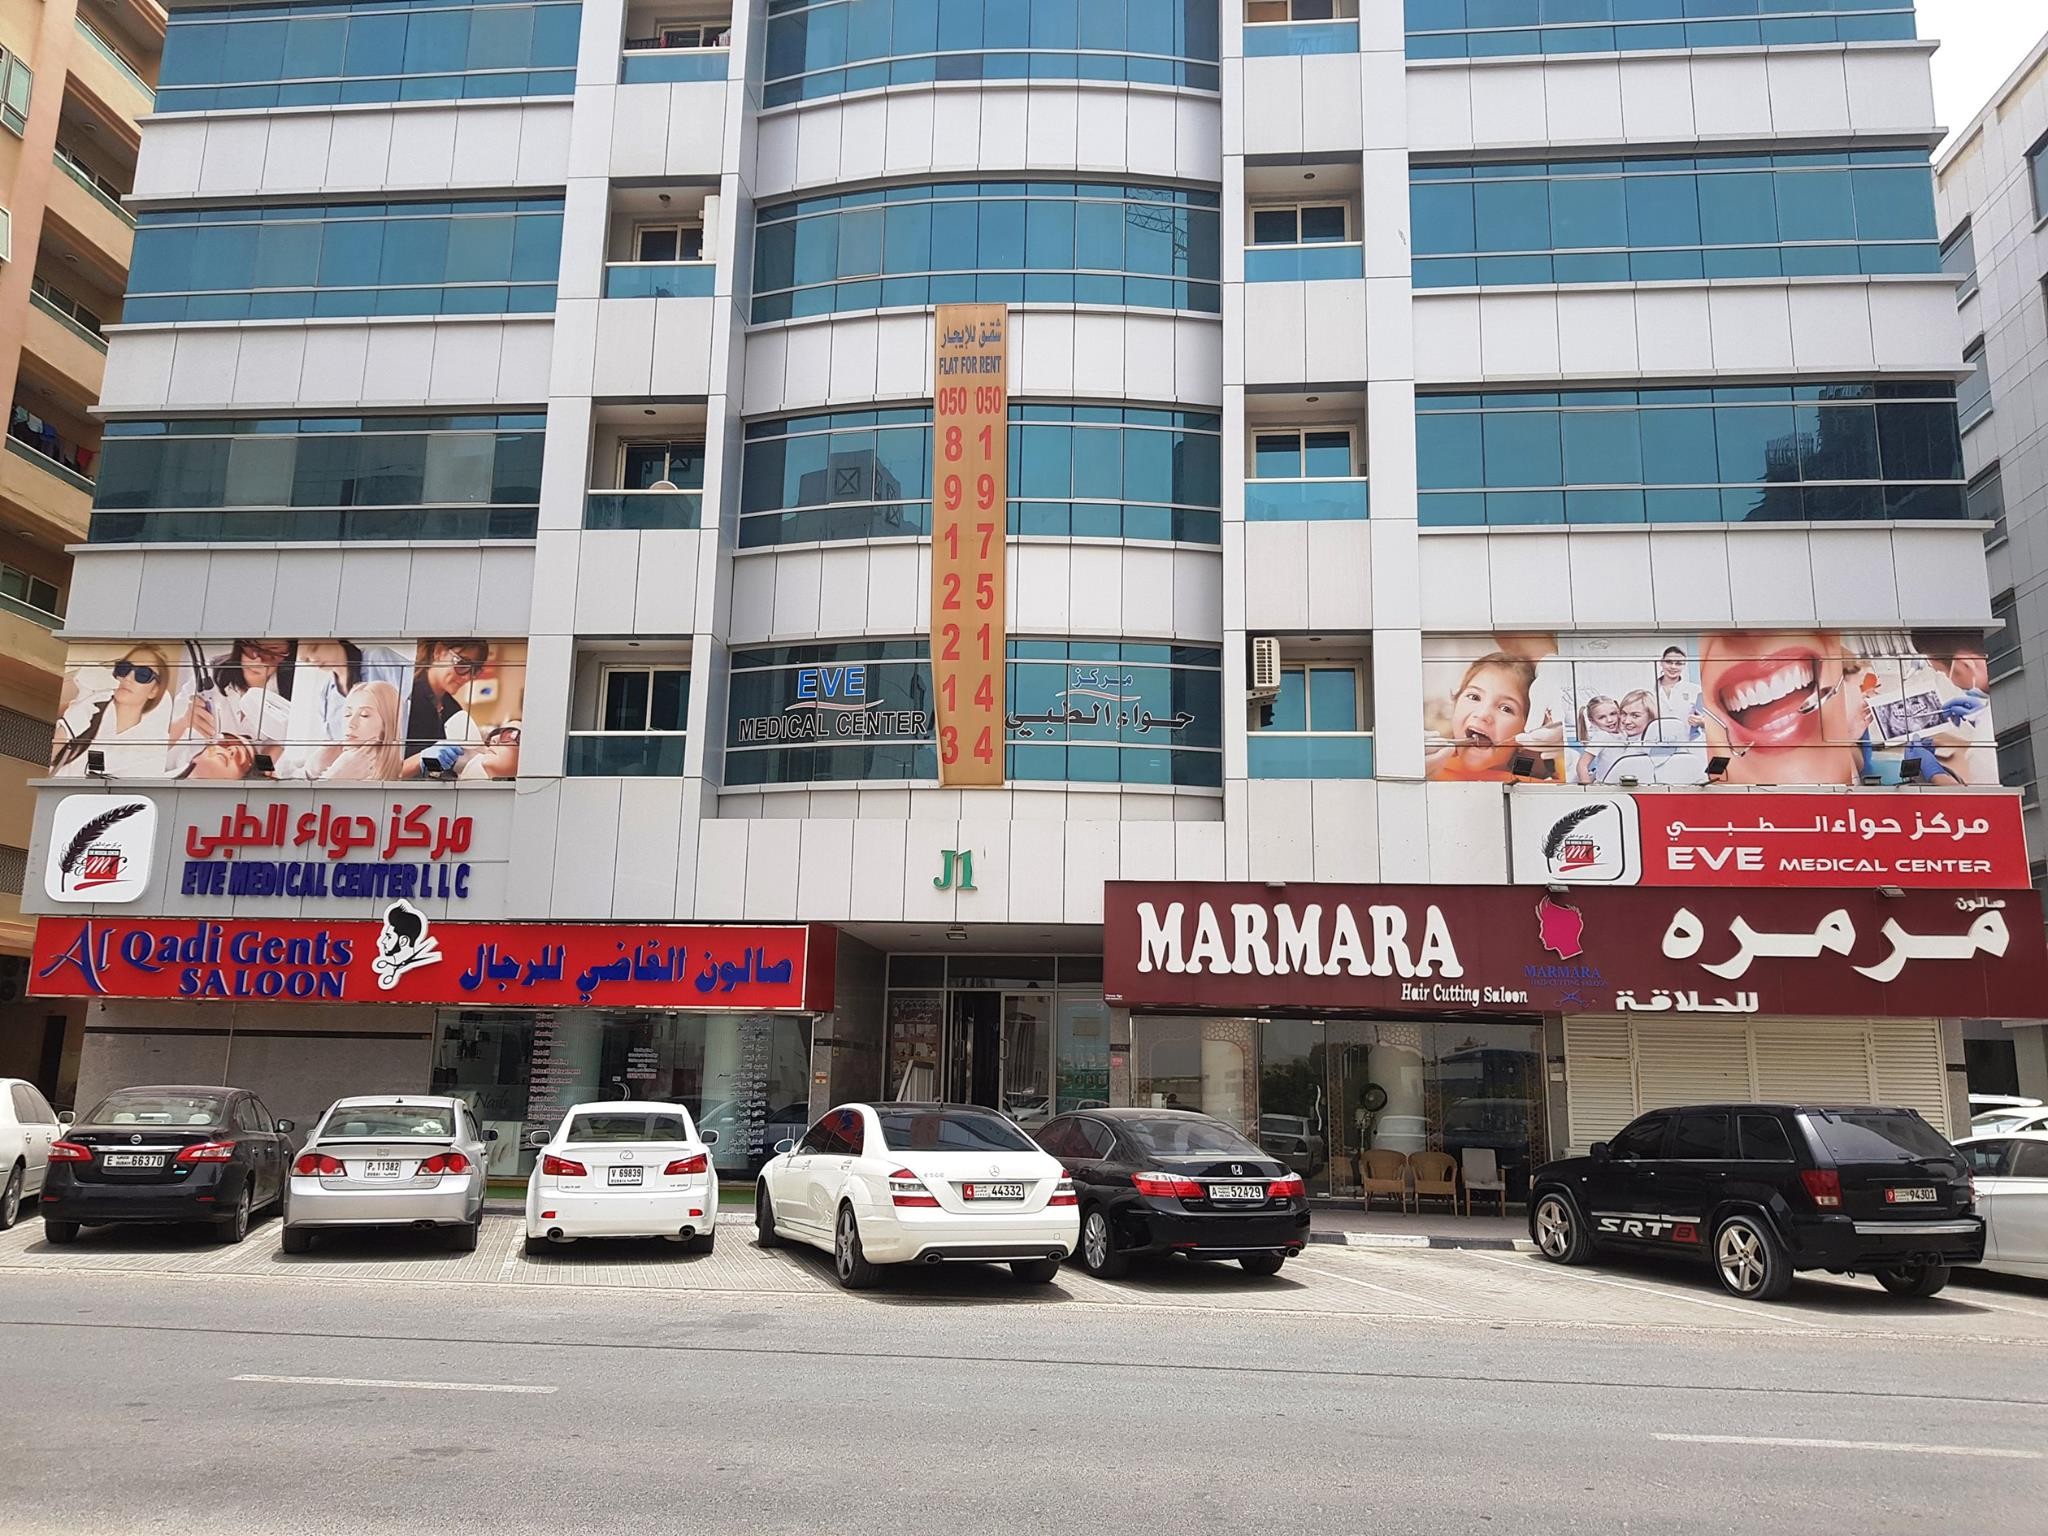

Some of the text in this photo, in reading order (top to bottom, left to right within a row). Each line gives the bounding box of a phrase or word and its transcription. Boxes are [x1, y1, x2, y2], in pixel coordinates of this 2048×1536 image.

[939, 355, 1001, 375] FLAT FOR RENT
[939, 385, 1001, 415] 050 050
[797, 666, 866, 699] EVE
[1072, 667, 1133, 690] مركز
[738, 710, 927, 742] MEDICAL CENTER
[1004, 699, 1196, 738] حواء الطبي
[293, 803, 377, 861] حواء
[382, 803, 474, 861] مركز
[1830, 808, 1902, 840] حواء
[1909, 810, 1990, 841] مركز
[933, 848, 978, 892] J1
[1666, 846, 1993, 874] EVE MEDICAL CENTER
[181, 860, 227, 896] EVE
[227, 861, 328, 897] MEDICAL
[331, 862, 418, 899] CENTER
[1954, 895, 2006, 912] صالون
[1136, 901, 1464, 979] MARMARA
[38, 920, 354, 994] Al Qadi Gents
[458, 940, 795, 1003] صالون القاضي للرجال
[1523, 965, 1601, 978] MARMARA
[178, 967, 348, 998] SALOON
[1400, 982, 1529, 1008] Hair Cutting Saloon
[1615, 989, 1760, 1014] للحلاقة
[106, 1155, 164, 1166] E 66370
[377, 1162, 399, 1171] 11382
[619, 1168, 642, 1178] 69839
[966, 1186, 972, 1196] 4
[991, 1184, 1022, 1196] 44332
[1211, 1186, 1218, 1197] A
[1887, 1190, 1895, 1200] 9
[1909, 1188, 1936, 1200] 94301
